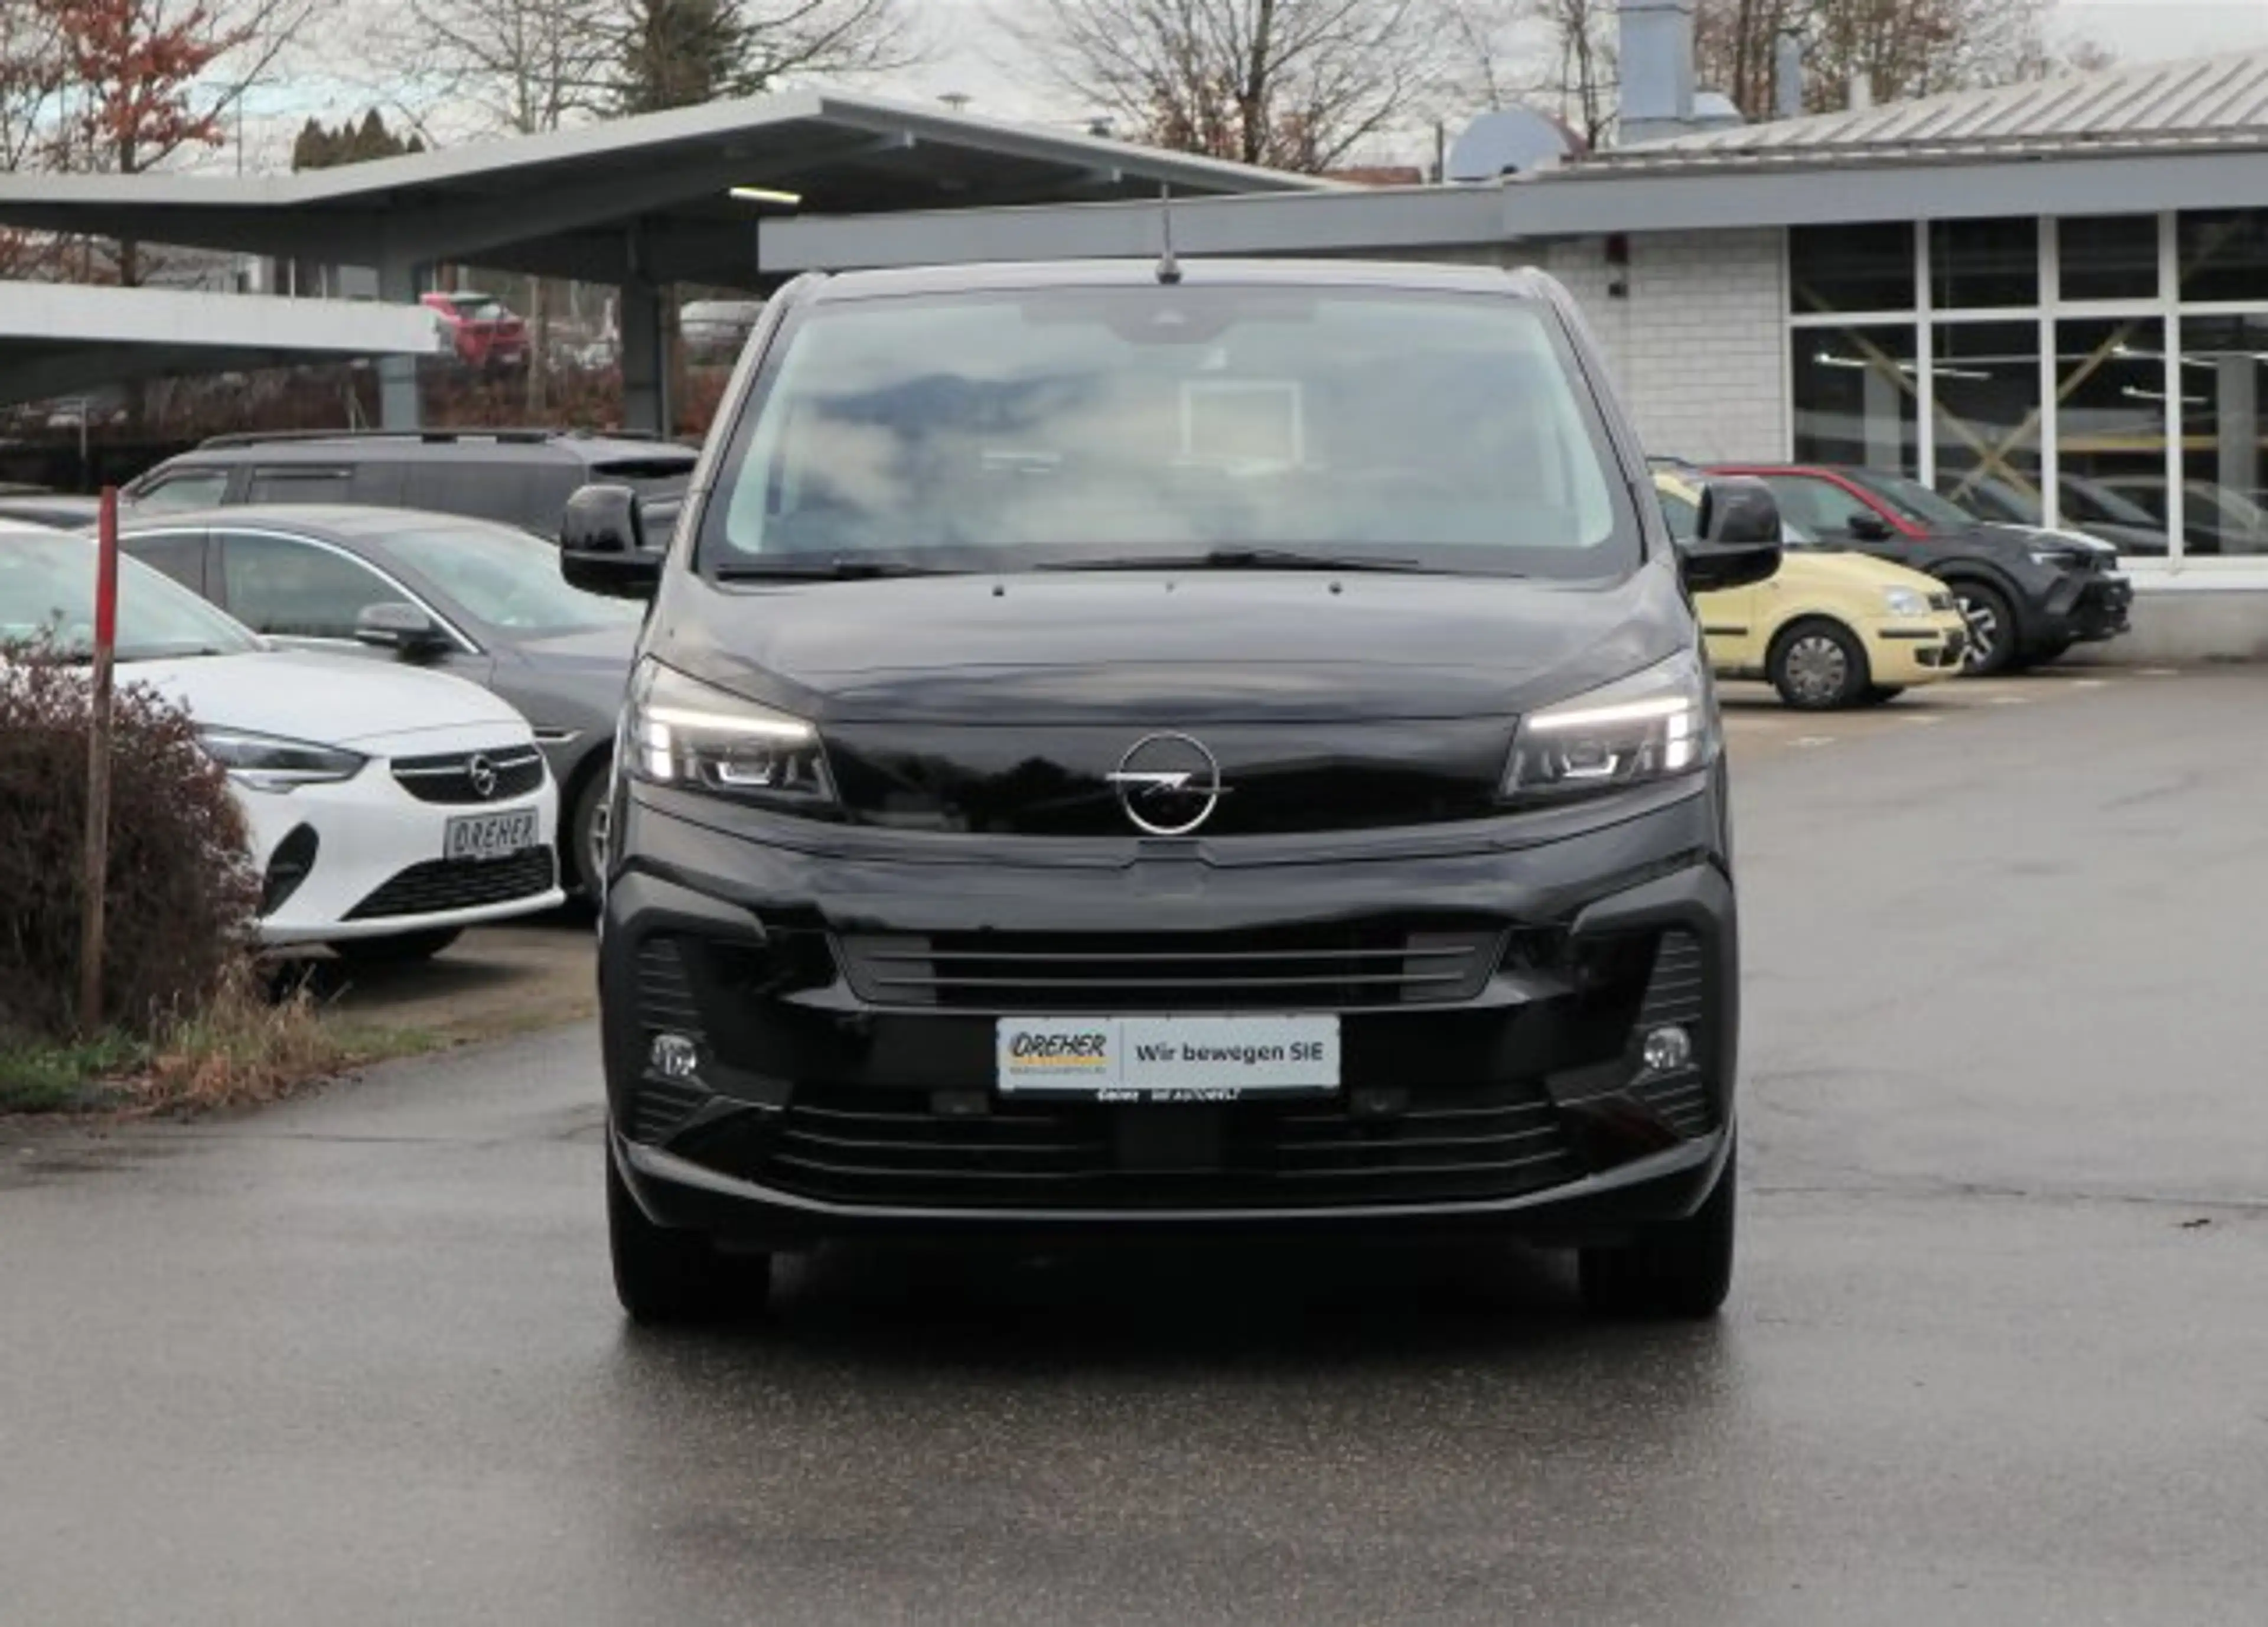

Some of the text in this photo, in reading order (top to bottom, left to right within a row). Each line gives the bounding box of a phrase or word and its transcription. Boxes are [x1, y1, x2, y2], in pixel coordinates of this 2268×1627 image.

[454, 815, 533, 852] DREHER
[1009, 1031, 1107, 1057] DREHER
[1136, 1042, 1324, 1065] Wir bewegen SIE
